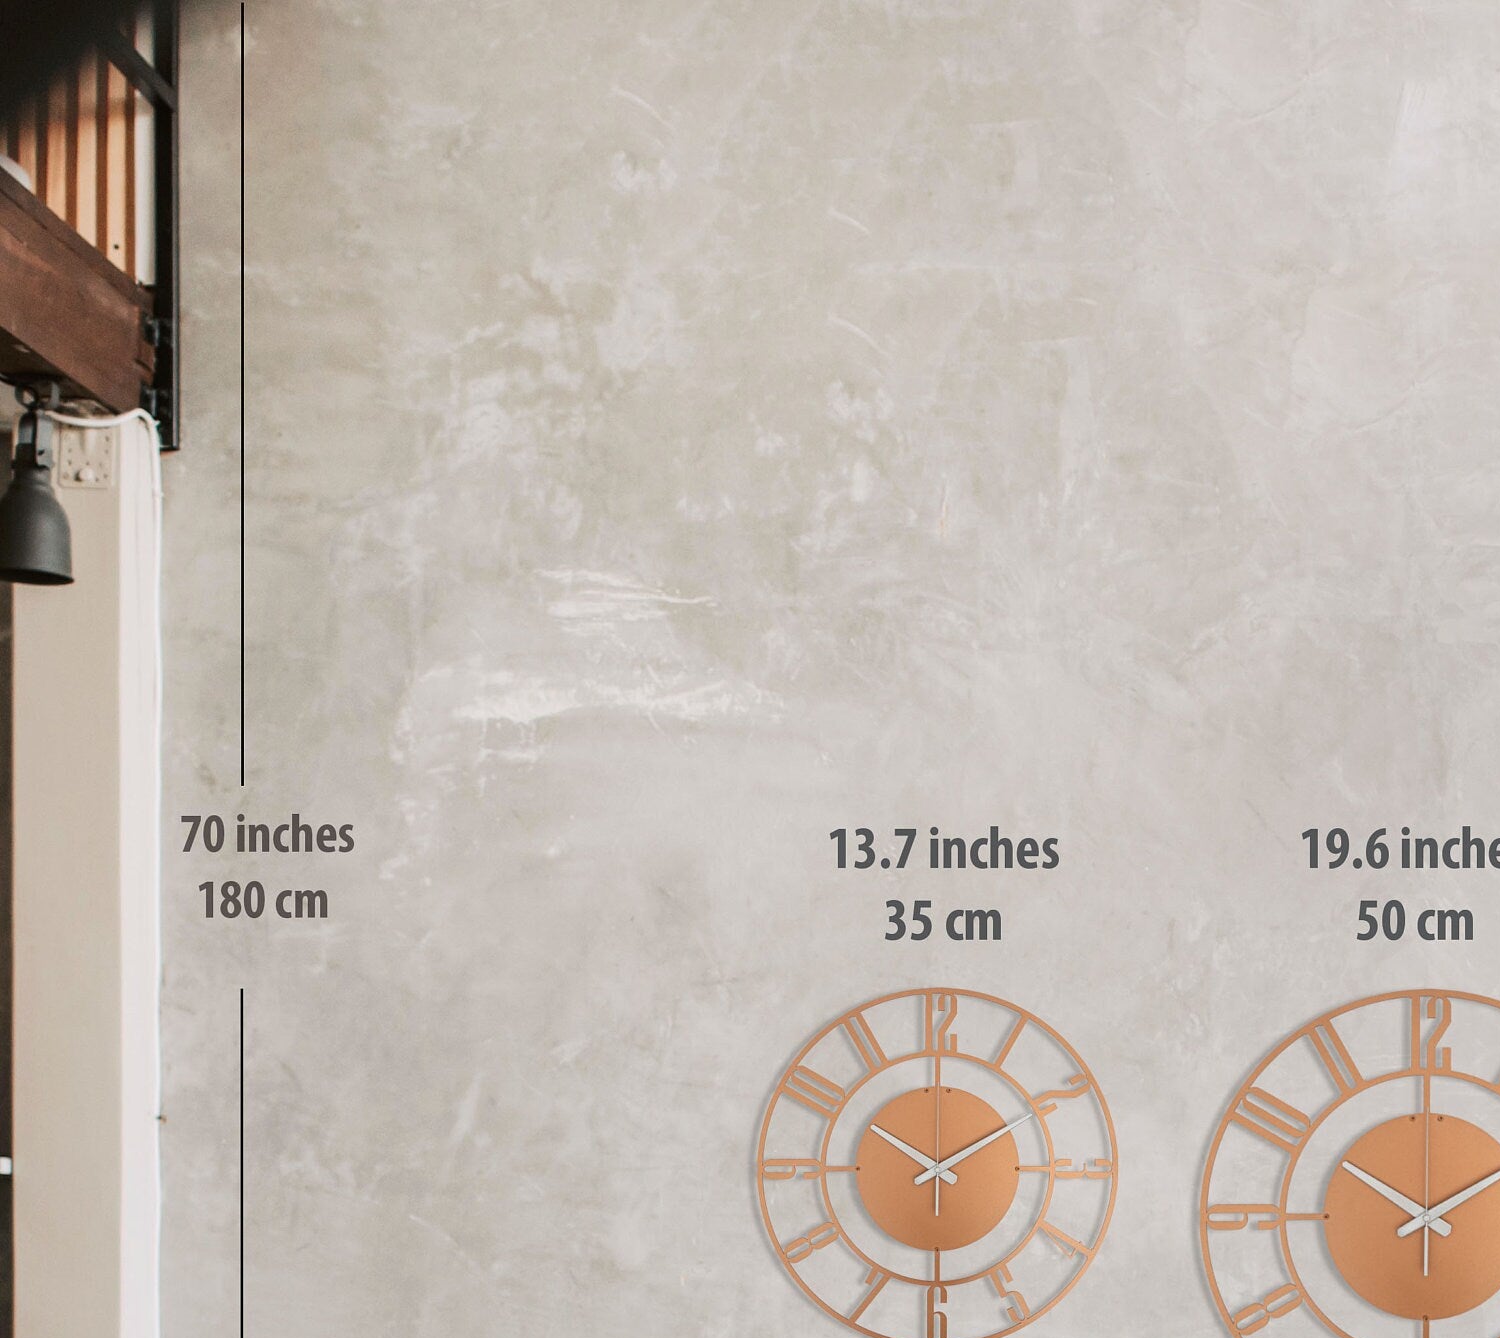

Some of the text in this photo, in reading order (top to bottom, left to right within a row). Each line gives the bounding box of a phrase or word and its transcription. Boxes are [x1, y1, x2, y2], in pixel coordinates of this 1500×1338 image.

[925, 992, 957, 1054] 12
[1410, 996, 1452, 1072] 12
[779, 1065, 845, 1120] 10
[1032, 1073, 1091, 1116] 2
[1229, 1086, 1311, 1154] 10
[762, 1158, 822, 1180] 9
[1054, 1158, 1113, 1179] 3
[785, 1221, 840, 1264] 8
[1037, 1220, 1095, 1259] 4
[1206, 1204, 1281, 1231] 9
[848, 1266, 891, 1325] 7
[989, 1263, 1031, 1324] 5
[1234, 1283, 1304, 1336] 8
